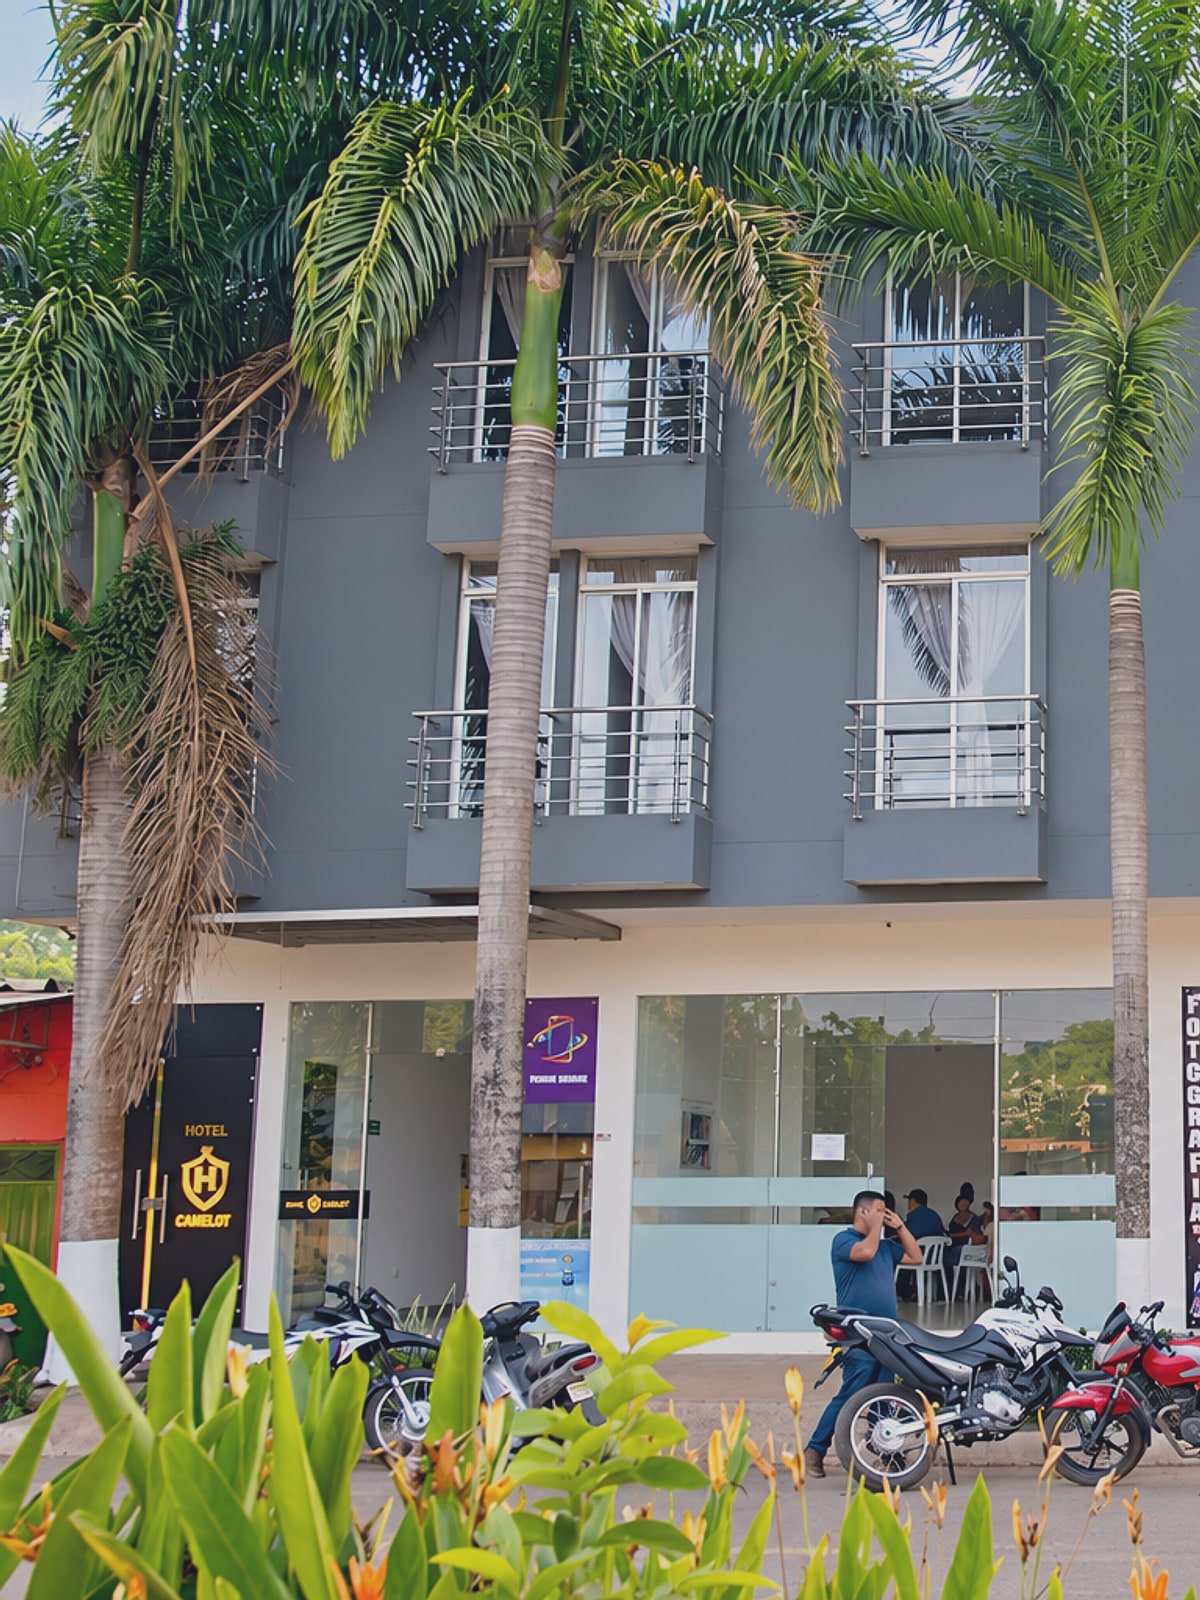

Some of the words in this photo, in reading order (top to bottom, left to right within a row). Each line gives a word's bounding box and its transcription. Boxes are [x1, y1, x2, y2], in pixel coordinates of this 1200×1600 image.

[185, 1125, 228, 1137] HOTEL
[194, 1166, 217, 1194] H
[175, 1214, 232, 1228] CAMELOT
